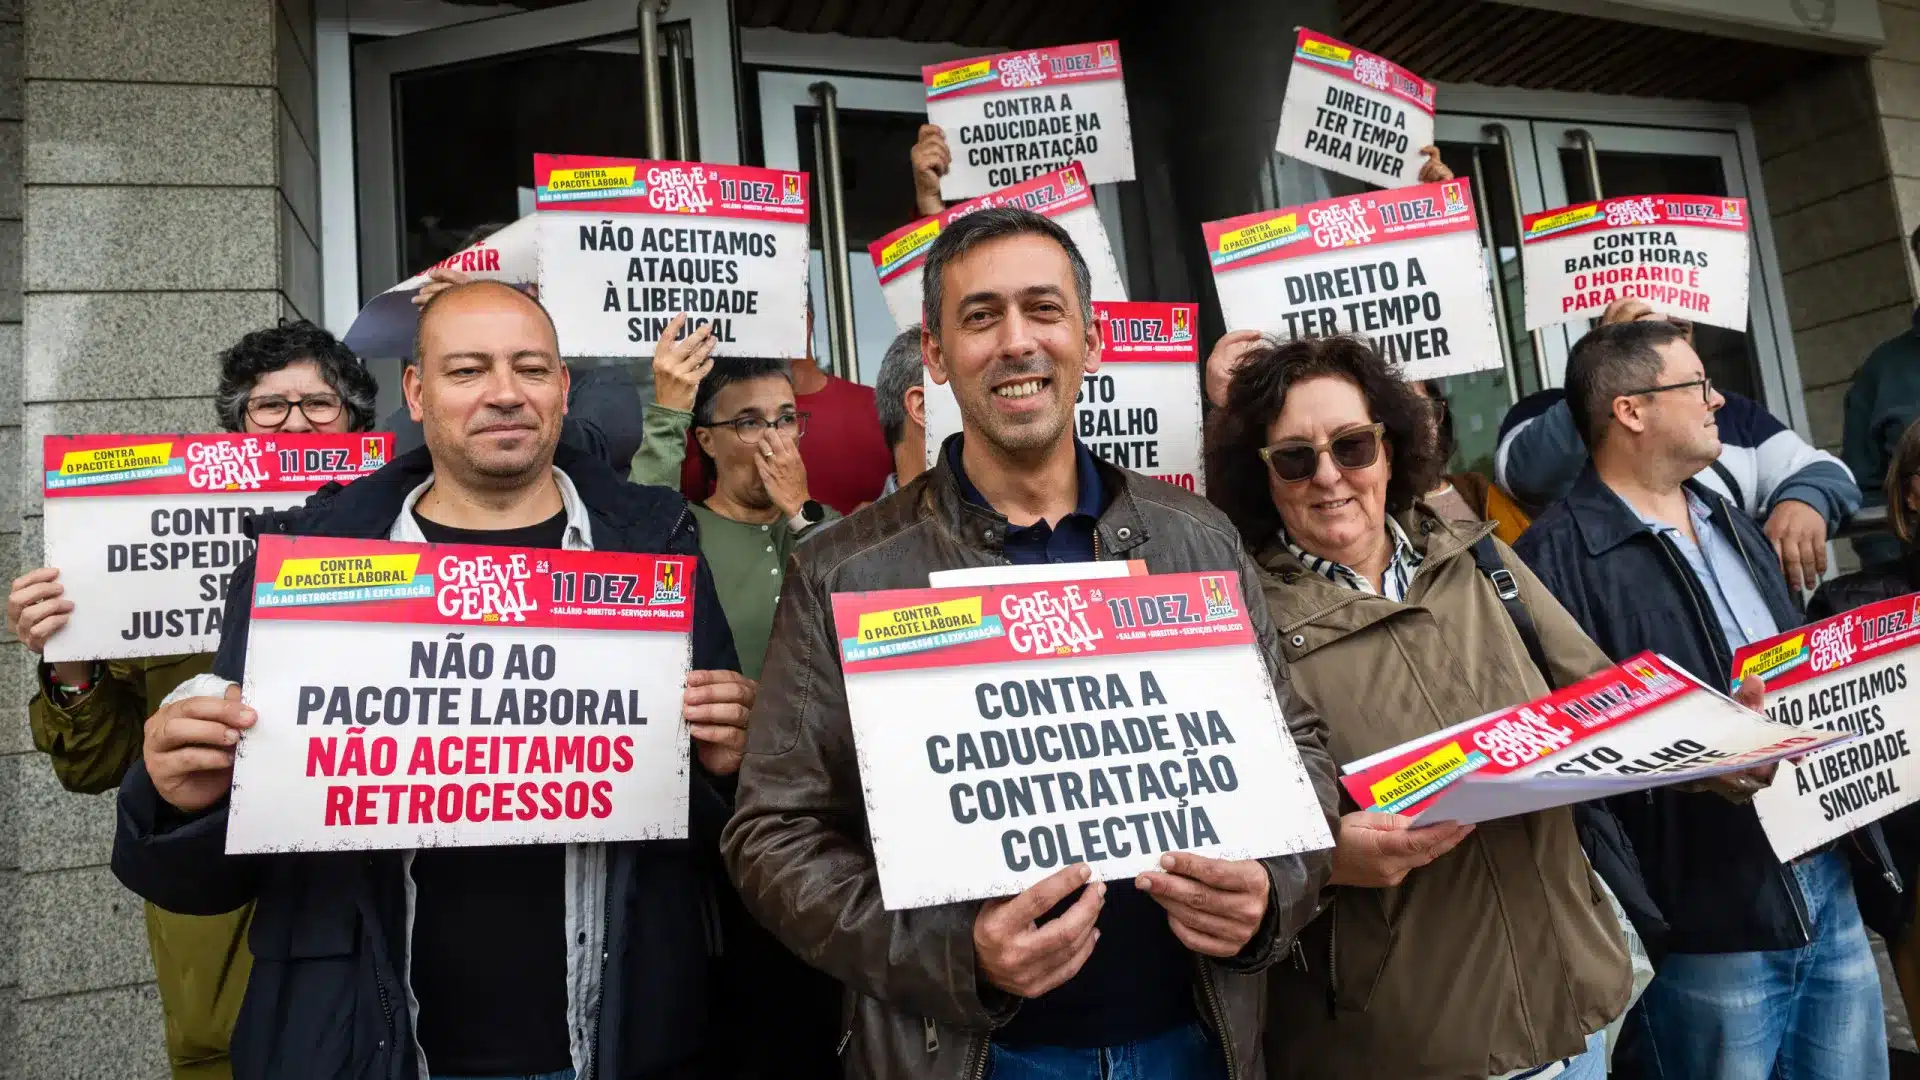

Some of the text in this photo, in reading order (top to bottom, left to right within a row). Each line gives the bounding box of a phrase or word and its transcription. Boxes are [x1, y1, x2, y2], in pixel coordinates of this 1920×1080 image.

[998, 52, 1041, 75] GREVE
[1001, 66, 1048, 88] GERAL
[983, 93, 1073, 119] CONTRA A
[1325, 86, 1391, 125] DIREITO
[1394, 110, 1406, 130] A
[959, 112, 1101, 145] CADUCIDADE NA
[1316, 106, 1408, 154] TER TEMPO
[968, 132, 1098, 167] CONTRATAÇÃO
[1304, 129, 1404, 178] PARA VIVER
[574, 170, 607, 179] CONTRA
[647, 166, 707, 192] GREVE
[649, 185, 713, 213] GERAL
[720, 179, 780, 204] 11 DEZ.
[1308, 198, 1366, 229] GREVE
[1378, 198, 1442, 226] 11 DEZ.
[1607, 206, 1661, 226] GERAL
[580, 219, 776, 258] NÃO ACEITAMOS
[1230, 235, 1258, 250] PACOTE
[1259, 225, 1293, 241] LABORAL
[1240, 223, 1271, 238] CONTRA
[1313, 216, 1377, 248] GERAL
[1593, 231, 1677, 251] CONTRA
[627, 257, 738, 284] ATAQUES
[1564, 248, 1709, 274] BANCO HORAS
[1574, 262, 1700, 290] O HORÁRIO É
[1284, 257, 1427, 305] DIREITO A
[603, 280, 758, 315] À LIBERDADE
[1562, 284, 1711, 313] PARA CUMPRIR
[1110, 318, 1168, 343] 11 DEZ.
[1281, 291, 1442, 345] TER TEMPO
[1369, 327, 1451, 365] VIVER
[1075, 407, 1158, 438] BALHO
[67, 455, 164, 473] O PACOTE LABORAL
[94, 448, 135, 460] CONTRA
[186, 437, 262, 468] GREVE
[278, 448, 356, 473] 11 DEZ.
[188, 460, 270, 490] GERAL
[151, 507, 276, 537] CONT
[284, 570, 407, 587] O PACOTE LABORAL
[320, 558, 372, 572] CONTRA
[438, 553, 531, 592] GREVE
[536, 561, 549, 569] 24
[259, 594, 279, 605] NÃO
[281, 594, 294, 604] AO
[296, 590, 355, 604] RETROCESSO
[437, 581, 538, 623] GERAL
[552, 571, 646, 606] 11 DEZ.
[893, 605, 941, 623] CONTRA
[1001, 585, 1088, 624] GREVE
[1106, 593, 1202, 629] 11 DEZ.
[121, 608, 222, 640] JUSTA
[865, 613, 976, 640] O PACOTE LABORAL
[1008, 612, 1104, 655] GERAL
[1811, 614, 1854, 647] GREVE
[1862, 618, 1874, 643] 11
[1877, 609, 1908, 639] DEZ.
[409, 633, 556, 680] NÃO AO
[1760, 646, 1783, 662] CONTRA
[1771, 647, 1798, 666] LABORAL
[1811, 639, 1857, 673] GERAL
[296, 685, 648, 726] PACOTE LABORAL
[974, 671, 1168, 721] CONTRA A
[1808, 663, 1907, 721] ACEITAMOS
[305, 727, 635, 777] NÃO ACEITAMOS
[925, 709, 1236, 775] CADUCIDADE NA
[1491, 716, 1574, 767] GERAL
[1395, 761, 1432, 783] CONTRA
[1810, 728, 1911, 796] LIBERDADE
[949, 749, 1239, 826] CONTRATAÇÃO
[1379, 794, 1388, 803] O
[1388, 777, 1422, 799] PACOTE
[1819, 767, 1900, 822] SINDICAL
[324, 780, 614, 827] RETROCESSOS
[1001, 806, 1221, 873] COLECTIVA
